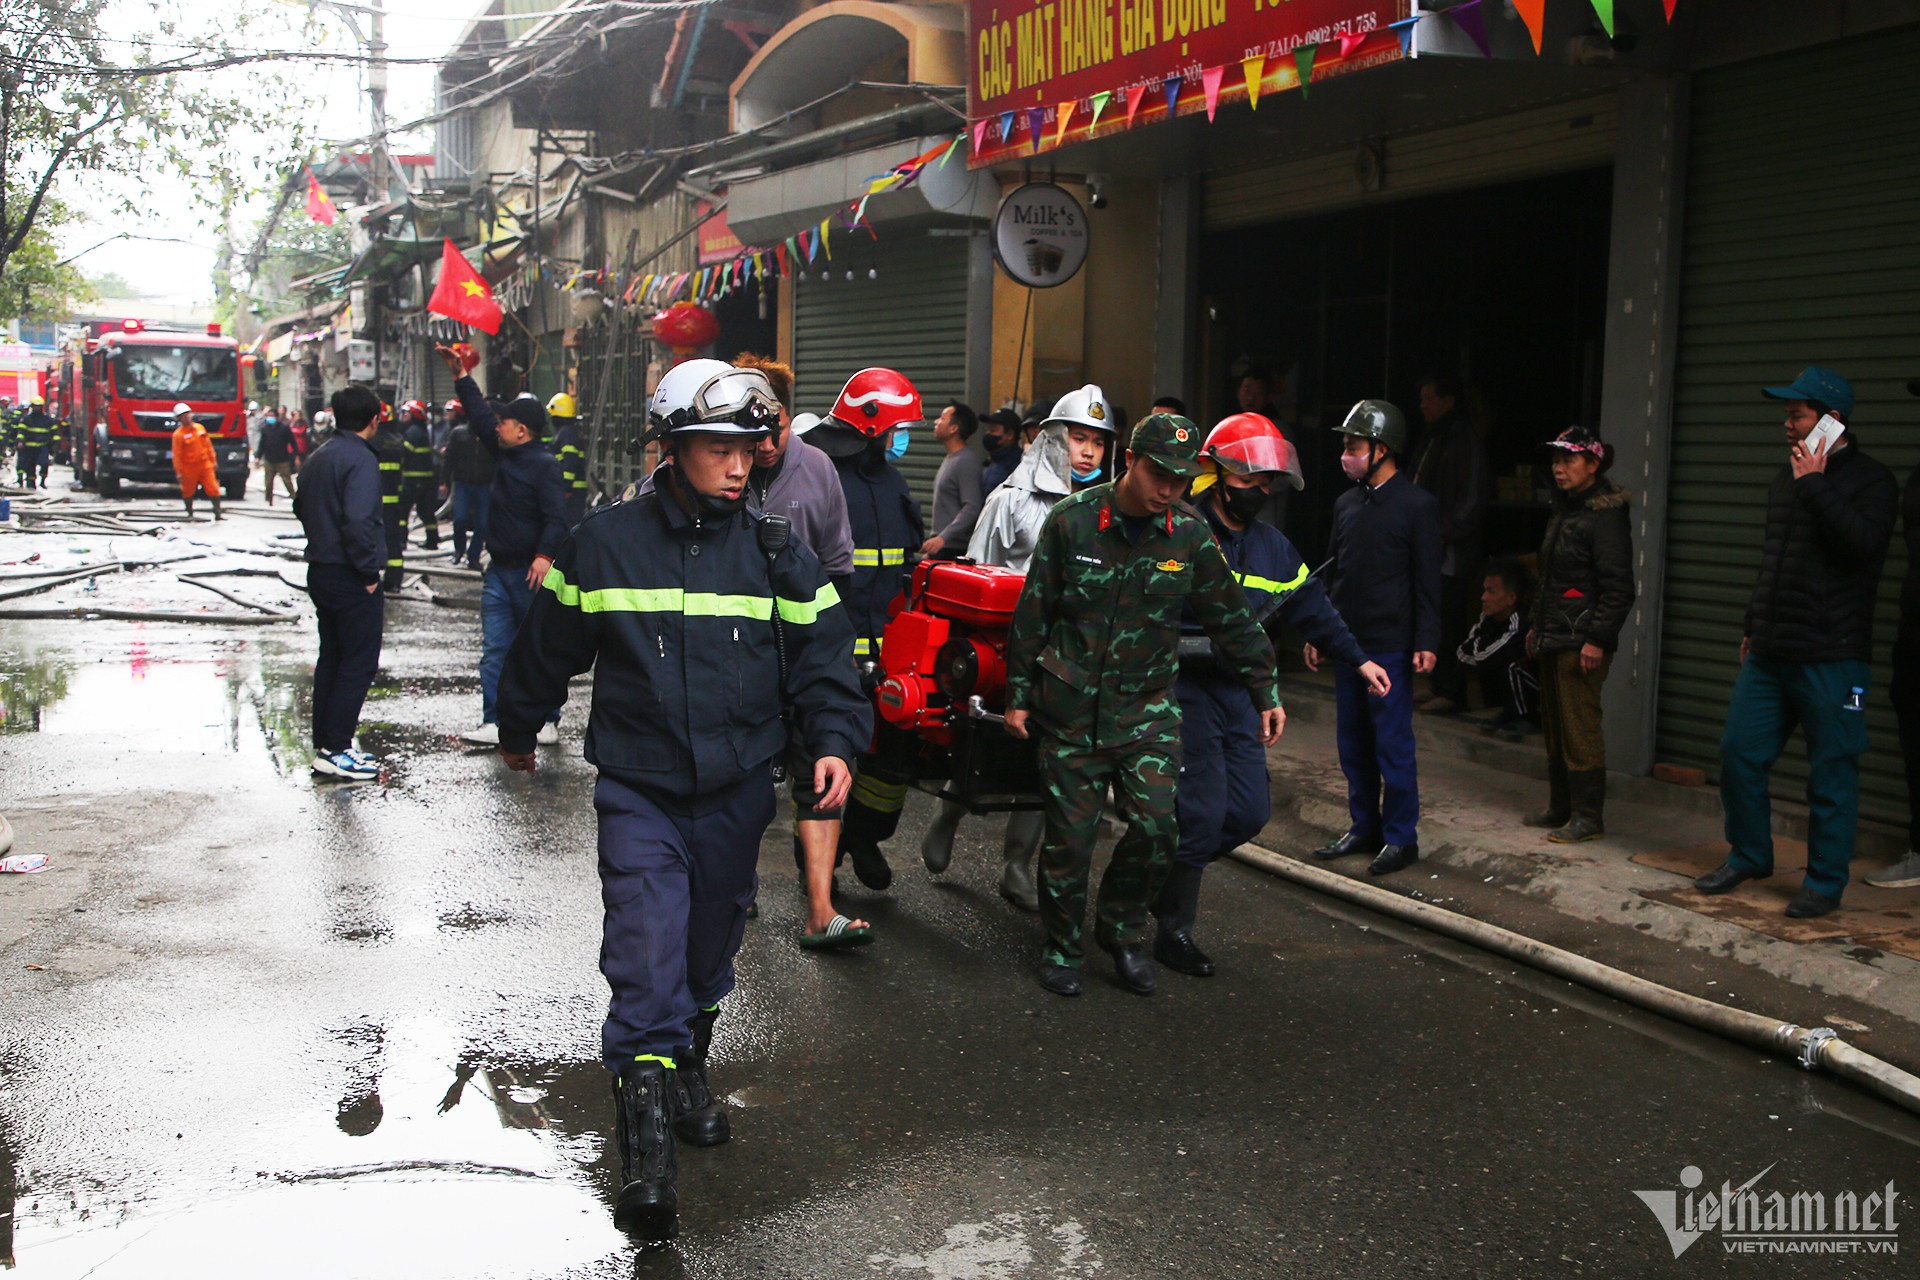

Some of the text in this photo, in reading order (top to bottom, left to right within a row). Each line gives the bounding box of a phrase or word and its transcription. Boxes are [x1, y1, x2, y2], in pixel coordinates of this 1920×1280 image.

[1304, 25, 1330, 46] 0902
[1356, 11, 1377, 33] 758
[979, 8, 1012, 101] CÁC
[1017, 0, 1055, 101] MẶT
[1120, 0, 1156, 56] GIA
[1014, 204, 1075, 226] Milk's
